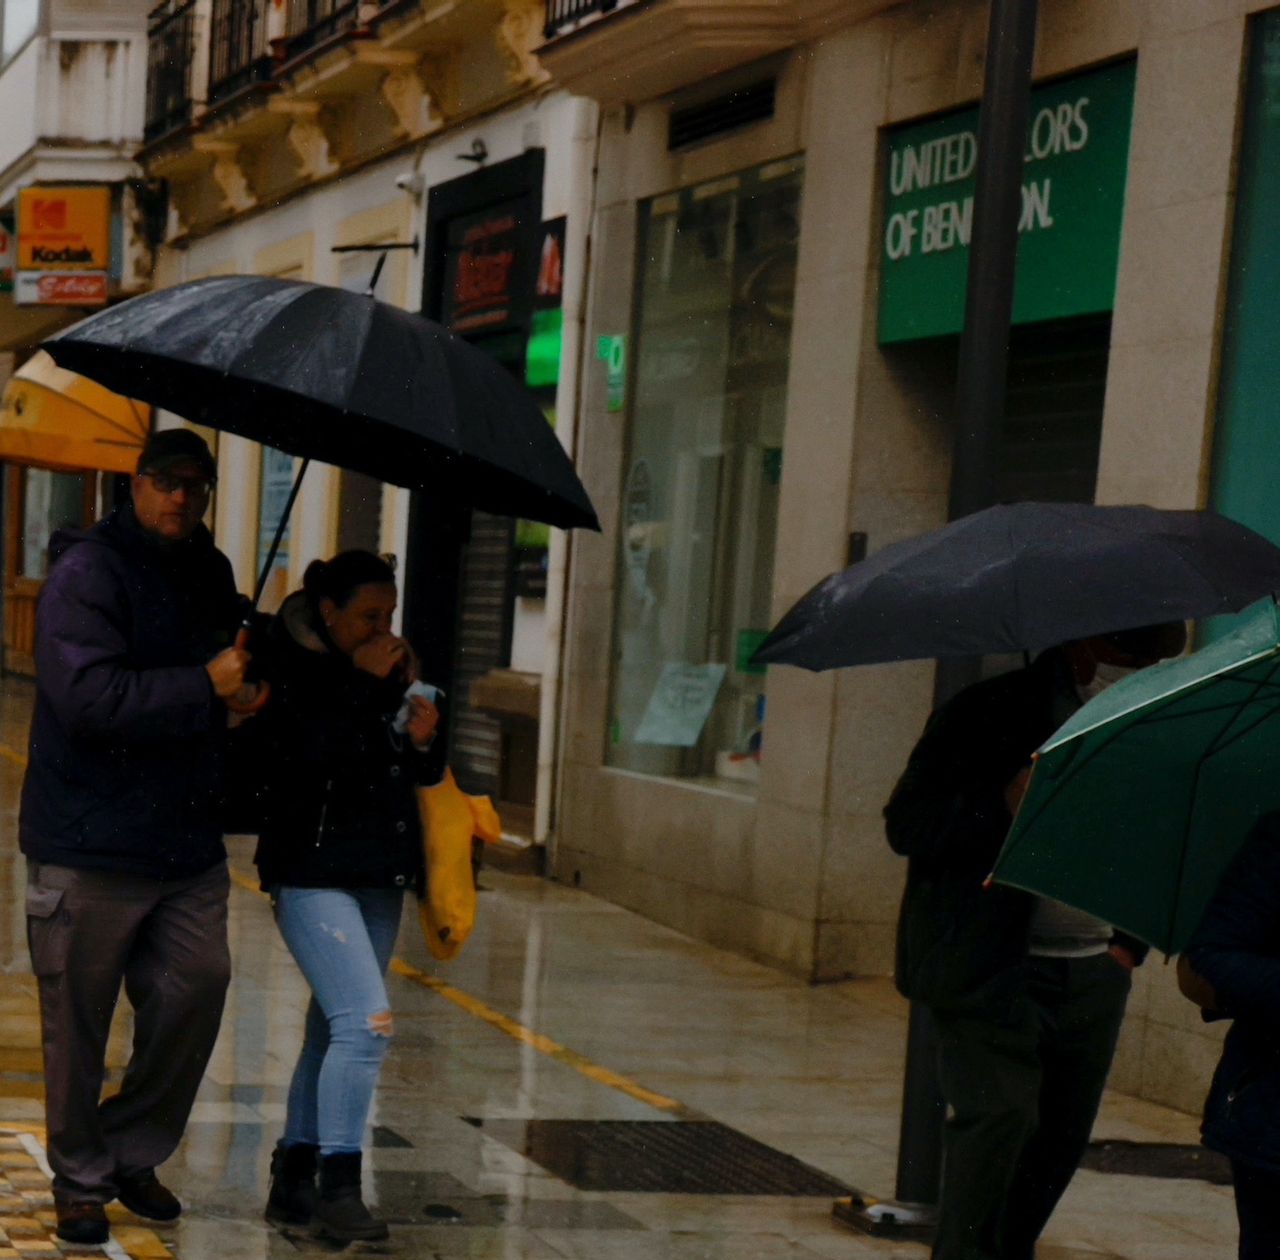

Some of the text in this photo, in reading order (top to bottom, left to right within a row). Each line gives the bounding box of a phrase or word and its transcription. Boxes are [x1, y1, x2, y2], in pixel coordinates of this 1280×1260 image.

[891, 98, 1089, 196] UNITED ORS
[31, 245, 94, 262] Kodak
[886, 210, 919, 260] OF
